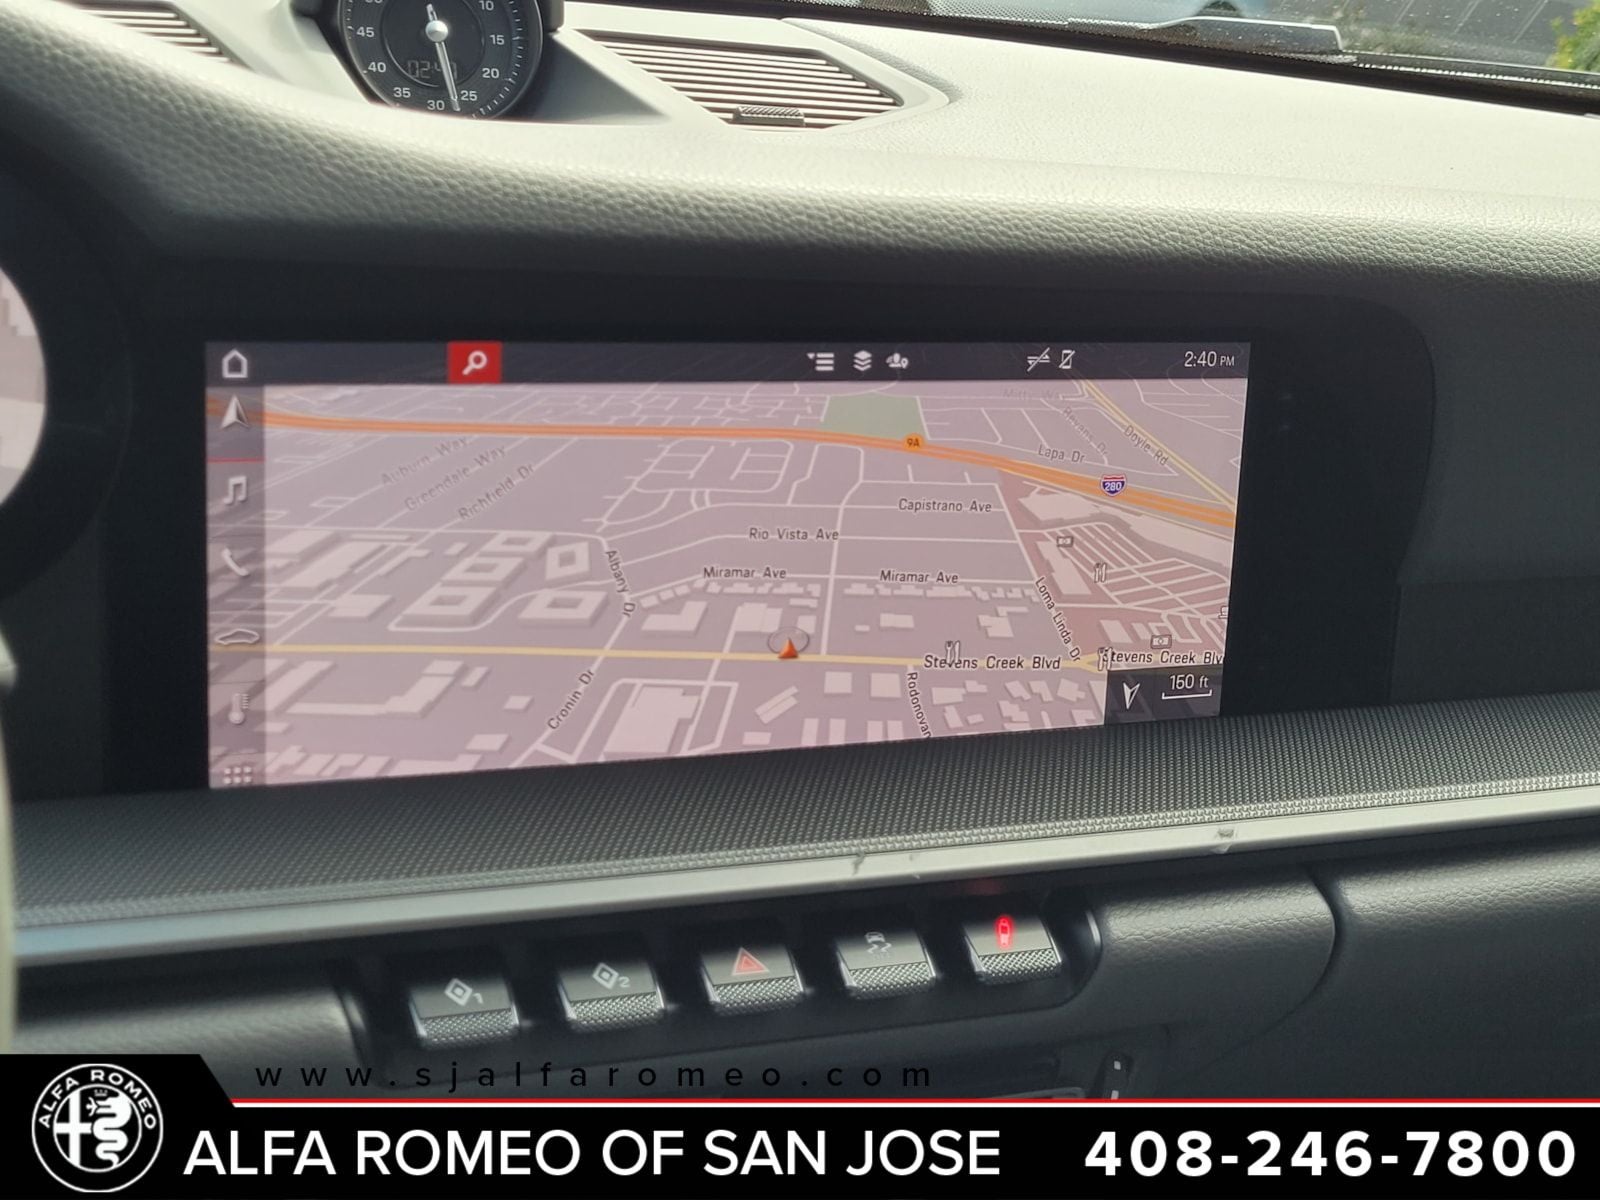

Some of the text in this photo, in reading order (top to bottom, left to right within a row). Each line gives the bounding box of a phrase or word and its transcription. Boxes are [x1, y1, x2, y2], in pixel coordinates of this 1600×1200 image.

[481, 0, 494, 11] 10
[356, 26, 375, 38] 45
[489, 34, 505, 46] 15
[367, 61, 387, 73] 40
[482, 67, 500, 79] 20
[393, 87, 411, 98] 35
[460, 90, 478, 101] 25
[427, 99, 445, 111] 30
[1184, 350, 1235, 368] 2:40 PM
[906, 437, 920, 448] 9A
[1124, 424, 1169, 466] Doyle Rd
[1038, 444, 1085, 463] Lapa Dr
[404, 445, 506, 511] Greendale Way
[458, 463, 534, 520] Richfield Dr
[1104, 481, 1122, 492] 280
[898, 497, 992, 514] Capistrano Ave
[749, 527, 839, 541] Rio Vista Ave
[703, 566, 787, 580] Miramar Ave
[879, 569, 959, 584] Miramar Ave
[605, 549, 636, 618] Albany Dr
[1035, 577, 1081, 662] Loma Linda Dr
[924, 654, 1061, 670] Stevens Creek Blvd
[1160, 650, 1196, 664] Creek
[1169, 673, 1209, 690] 150 ft
[547, 668, 595, 730] Cronin Dr
[906, 672, 932, 738] Rodonovan
